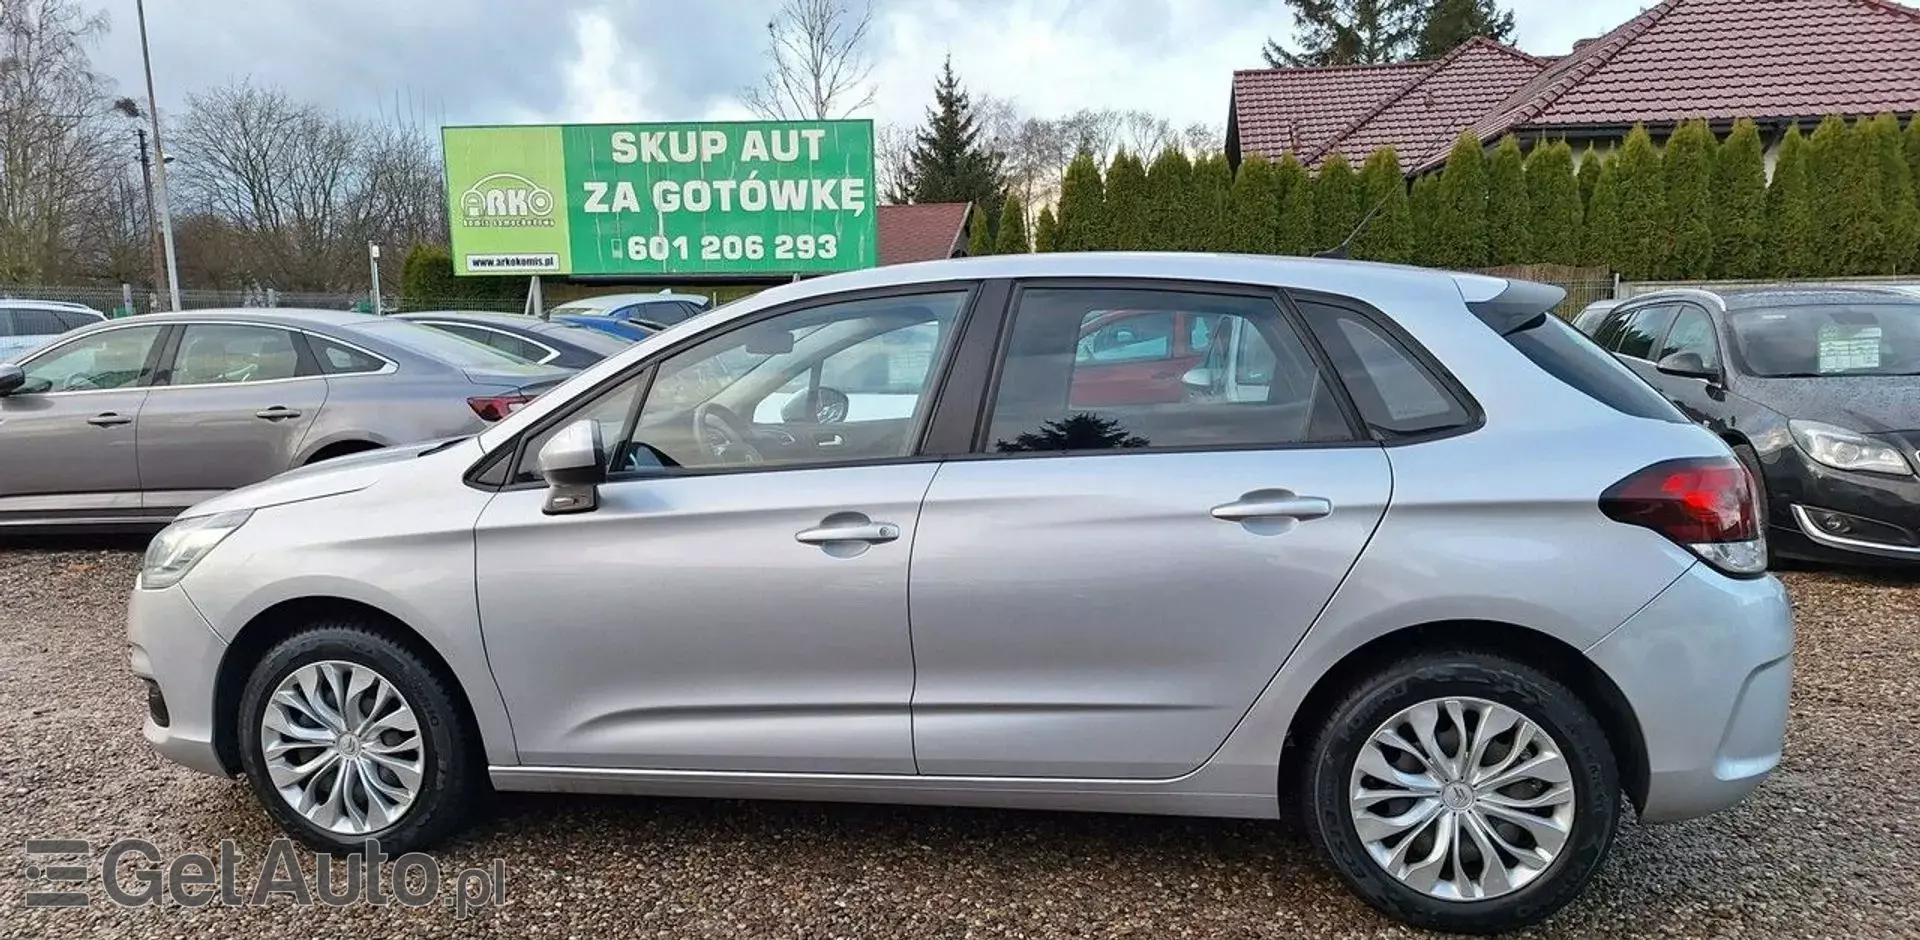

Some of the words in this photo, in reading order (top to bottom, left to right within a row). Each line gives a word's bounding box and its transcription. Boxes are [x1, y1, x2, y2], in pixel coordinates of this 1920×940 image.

[611, 130, 727, 163] SKUP
[741, 129, 826, 162] AUT
[461, 188, 554, 217] ARKO
[583, 181, 641, 213] ZA
[652, 170, 865, 218] GOTÓWKĘ
[627, 235, 688, 261] 601
[701, 235, 765, 260] 206
[774, 233, 838, 260] 293
[471, 256, 555, 269] www.arkokomis.pl
